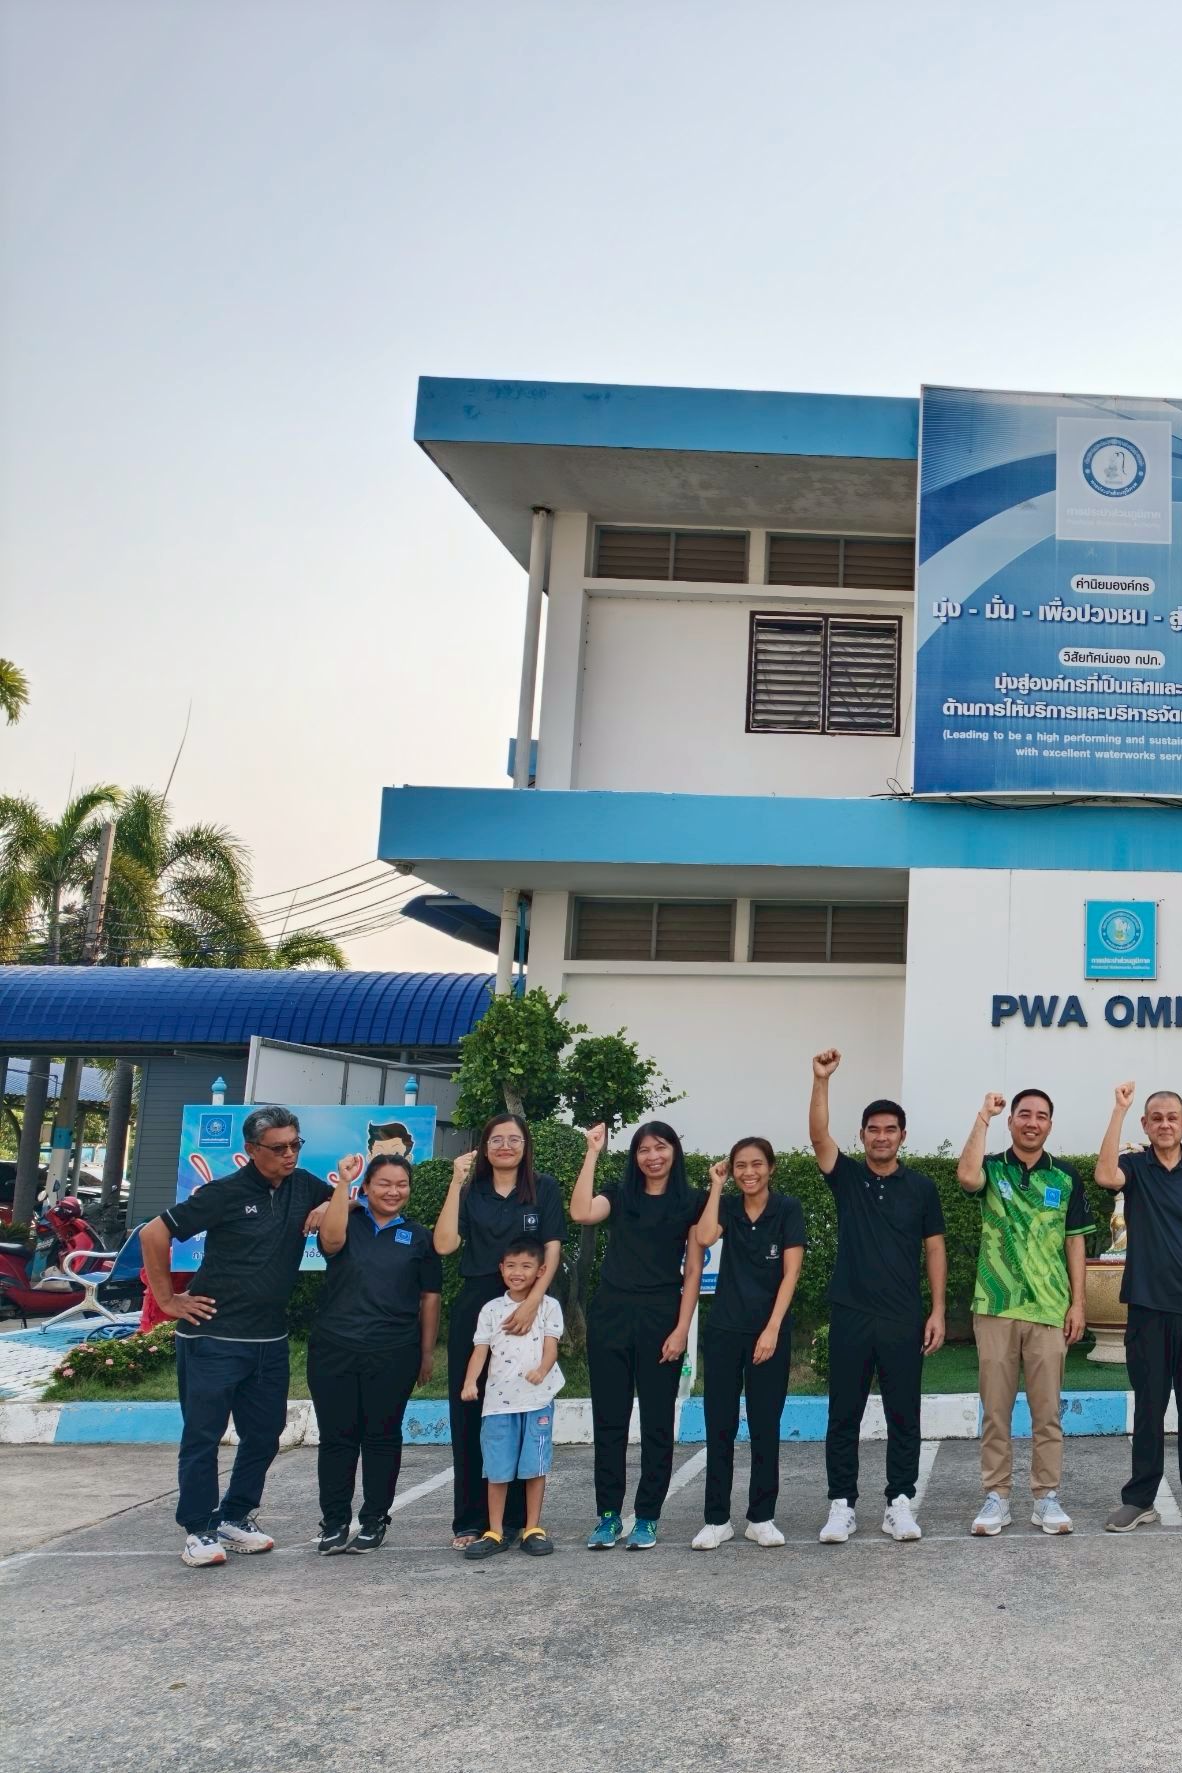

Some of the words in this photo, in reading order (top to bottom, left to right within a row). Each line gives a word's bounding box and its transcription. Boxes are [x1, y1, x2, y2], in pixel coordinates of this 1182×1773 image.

[1076, 577, 1150, 592] ค่านิยมองค์กร
[932, 596, 962, 623] มุ่ง
[985, 594, 1015, 620] มั่น
[1038, 596, 1146, 625] เพื่อปวงชน
[1063, 650, 1131, 665] วิสัยทัศน์ของ
[1135, 654, 1161, 666] กปภ.
[942, 729, 989, 741] (Leading
[993, 731, 1004, 740] to
[1008, 731, 1022, 740] be
[1025, 732, 1033, 740] a
[1036, 732, 1060, 743] high
[1063, 733, 1121, 745] performing
[1125, 736, 1145, 744] and
[1015, 747, 1039, 756] with
[1042, 748, 1091, 758] excellent
[1094, 750, 1156, 760] waterworks
[991, 994, 1088, 1027] PWA
